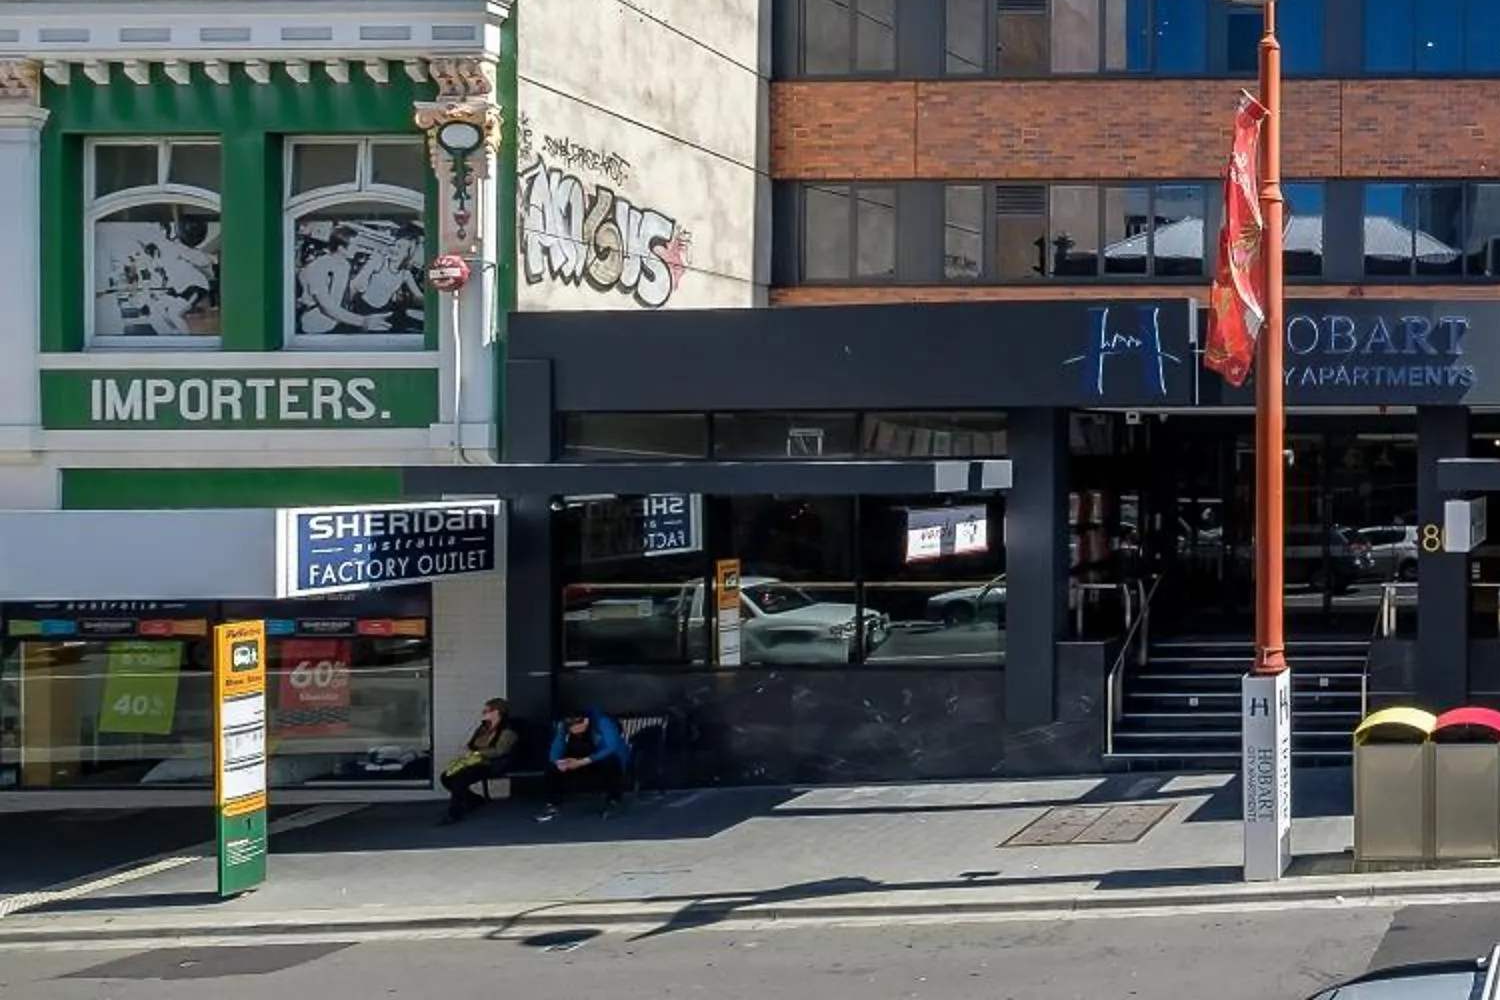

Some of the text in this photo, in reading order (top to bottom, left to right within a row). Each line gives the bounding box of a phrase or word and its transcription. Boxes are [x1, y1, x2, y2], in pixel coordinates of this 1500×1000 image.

[1287, 315, 1471, 355] OBART
[1300, 366, 1477, 387] APARTMENTS
[91, 378, 391, 421] IMPORTERS.
[309, 549, 486, 585] FACTORY OUTLET
[1257, 747, 1274, 823] HOBART
